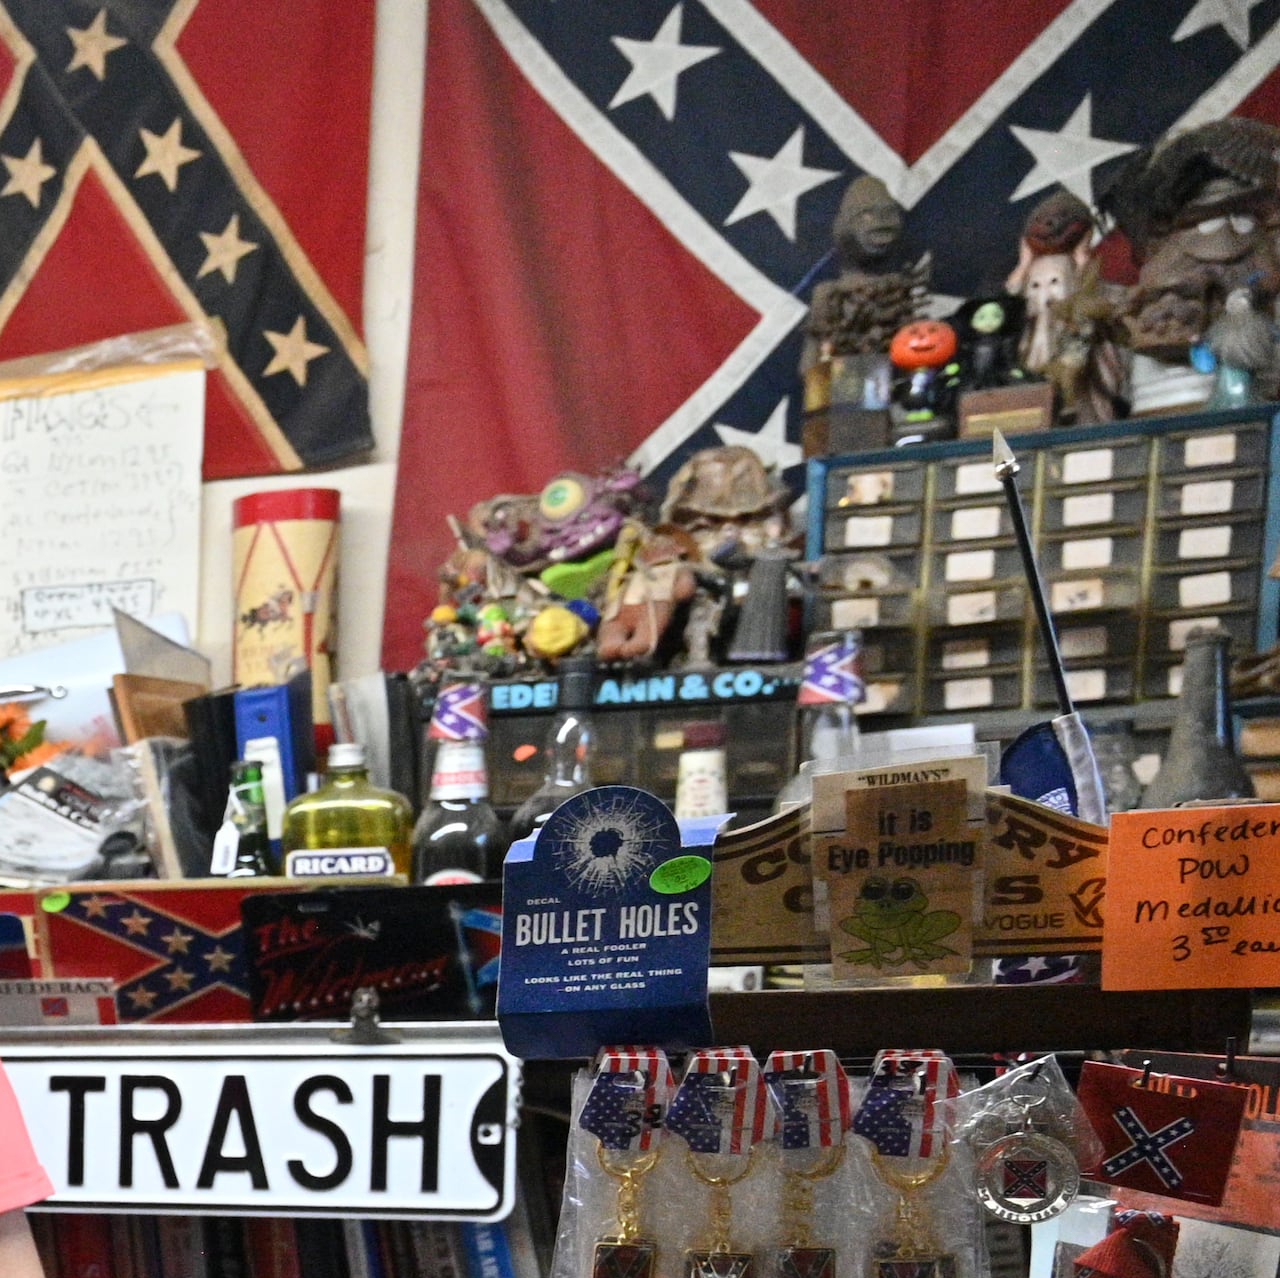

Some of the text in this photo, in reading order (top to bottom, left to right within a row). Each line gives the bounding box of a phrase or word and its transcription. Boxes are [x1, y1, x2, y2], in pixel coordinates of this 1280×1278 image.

[679, 673, 710, 700] &
[713, 670, 775, 699] CO.
[294, 855, 385, 877] RICARD
[826, 839, 977, 874] Eye Popping
[1177, 854, 1250, 884] POW
[526, 897, 561, 906] DECAL
[515, 901, 700, 947] BULLET HOLES
[983, 911, 1066, 932] VOGUE
[560, 942, 647, 956] A REAL FOOLER
[567, 955, 640, 967] LOTS OF FUN
[524, 967, 683, 985] LOOKS LIKE THE REAL THING
[583, 983, 608, 992] ANY
[610, 981, 646, 991] GLASS
[50, 1072, 442, 1195] TRASH
